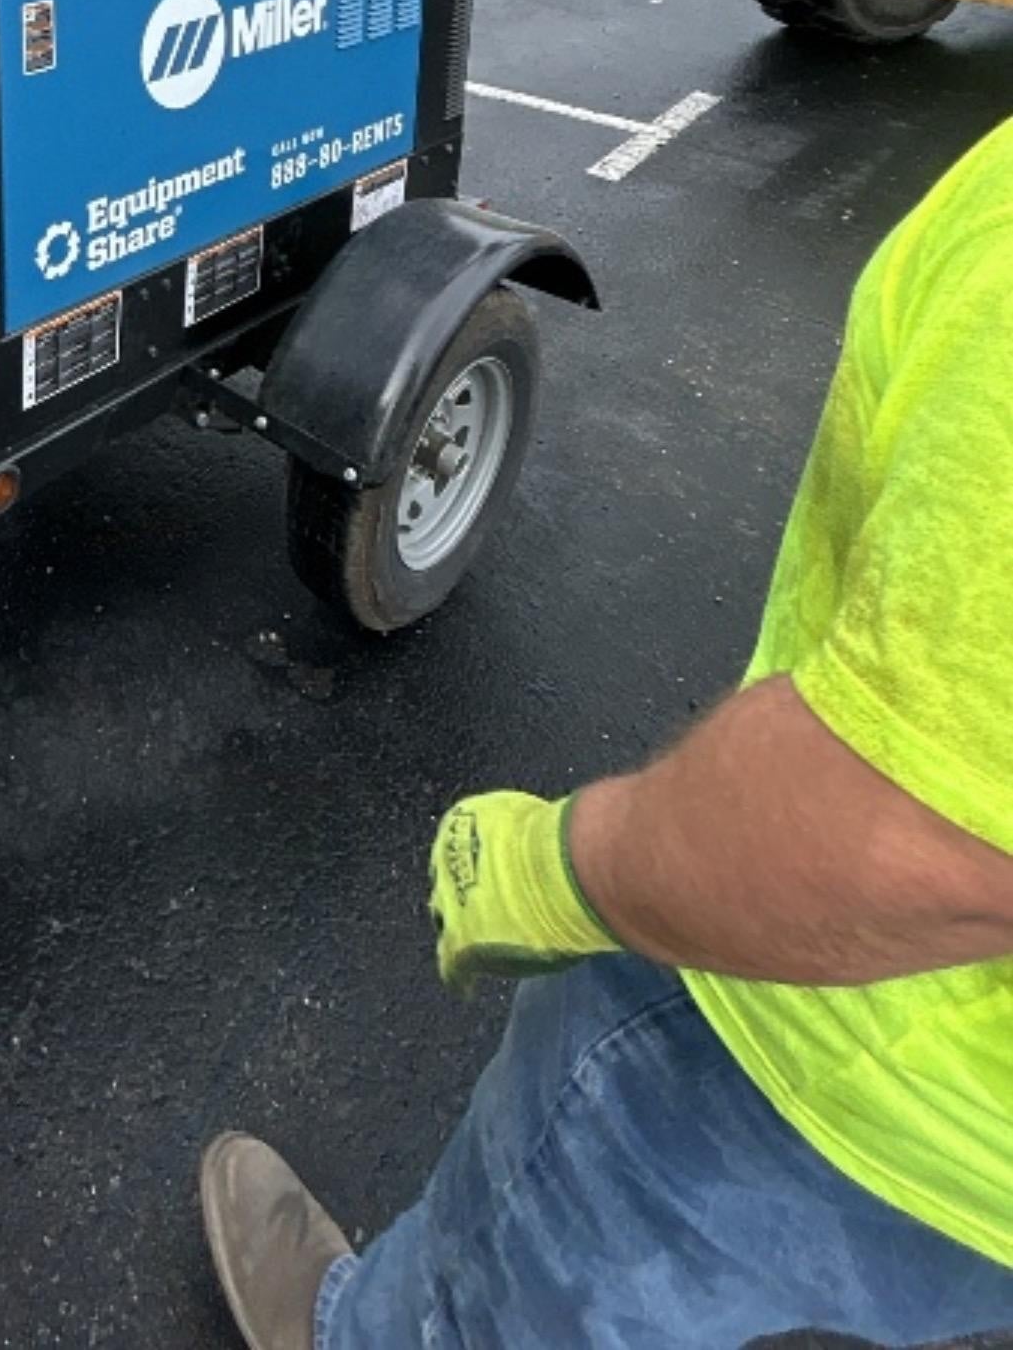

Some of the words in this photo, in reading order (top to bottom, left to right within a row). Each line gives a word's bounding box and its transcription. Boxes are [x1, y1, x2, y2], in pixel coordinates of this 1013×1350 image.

[86, 146, 246, 229] Equipment
[271, 112, 404, 190] 888-80-RENTS
[87, 214, 177, 271] Share
